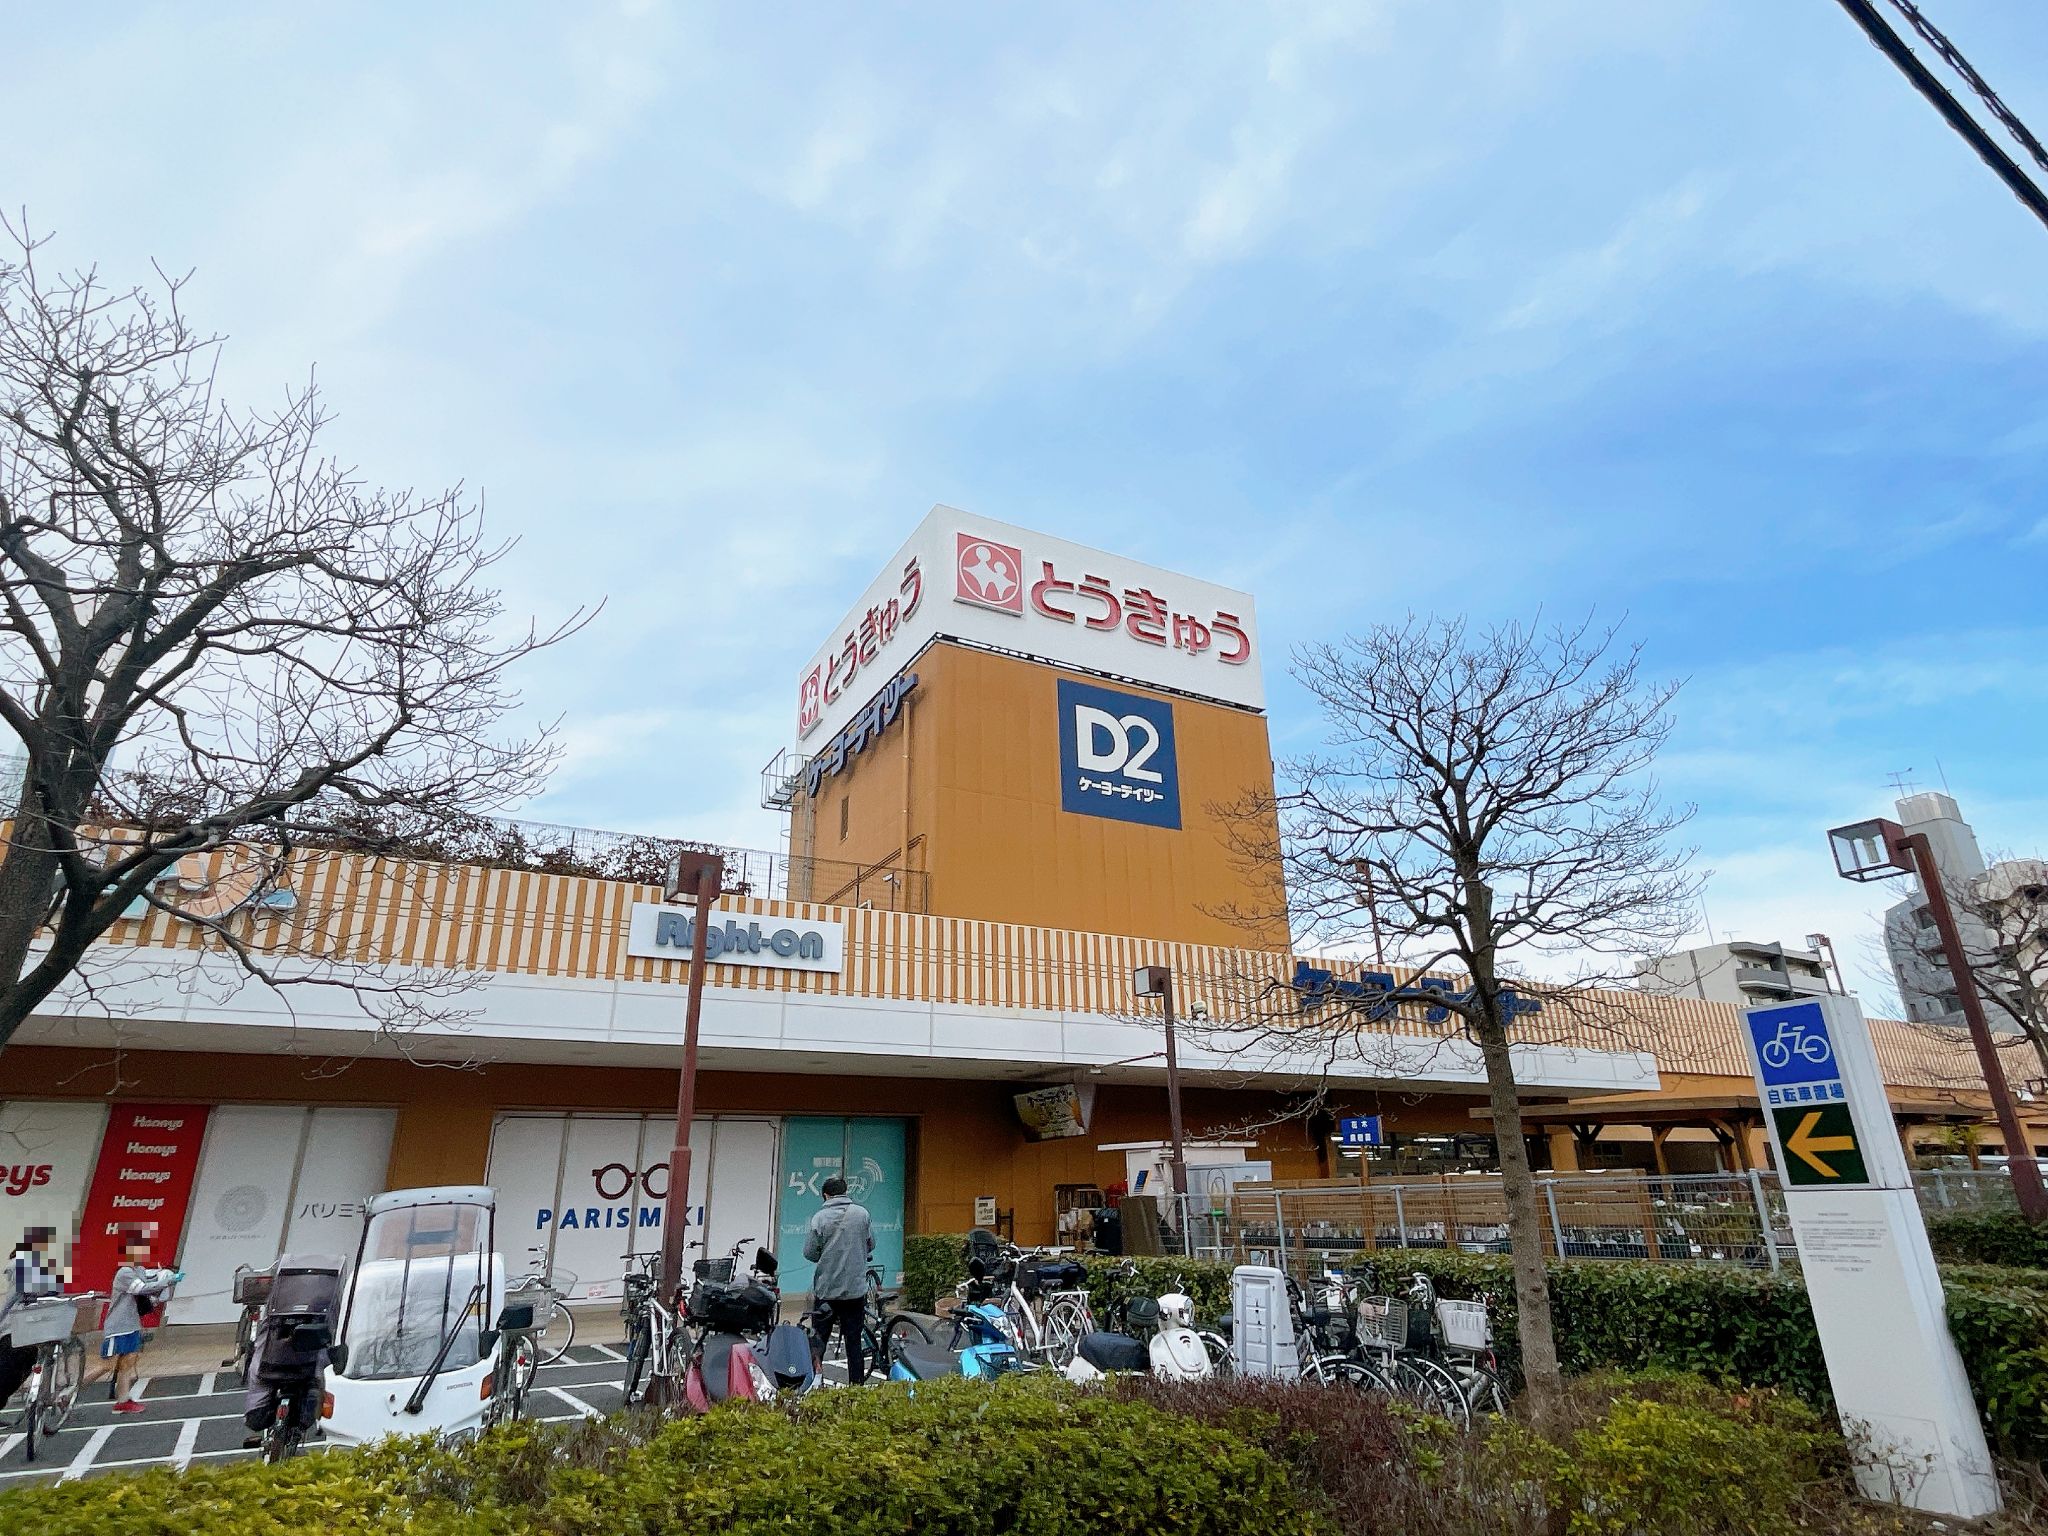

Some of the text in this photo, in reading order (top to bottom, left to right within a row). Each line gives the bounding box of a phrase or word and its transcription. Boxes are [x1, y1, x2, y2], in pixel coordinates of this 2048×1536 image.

[1029, 560, 1251, 665] とうきゅう
[823, 556, 923, 705] とうきゅう
[1075, 704, 1163, 784] D2
[1768, 1083, 1845, 1105] 自転車置場
[132, 1115, 185, 1131] Honeys
[126, 1141, 178, 1157] Honeys
[119, 1168, 171, 1183] Honeys
[112, 1195, 165, 1210] Honeys
